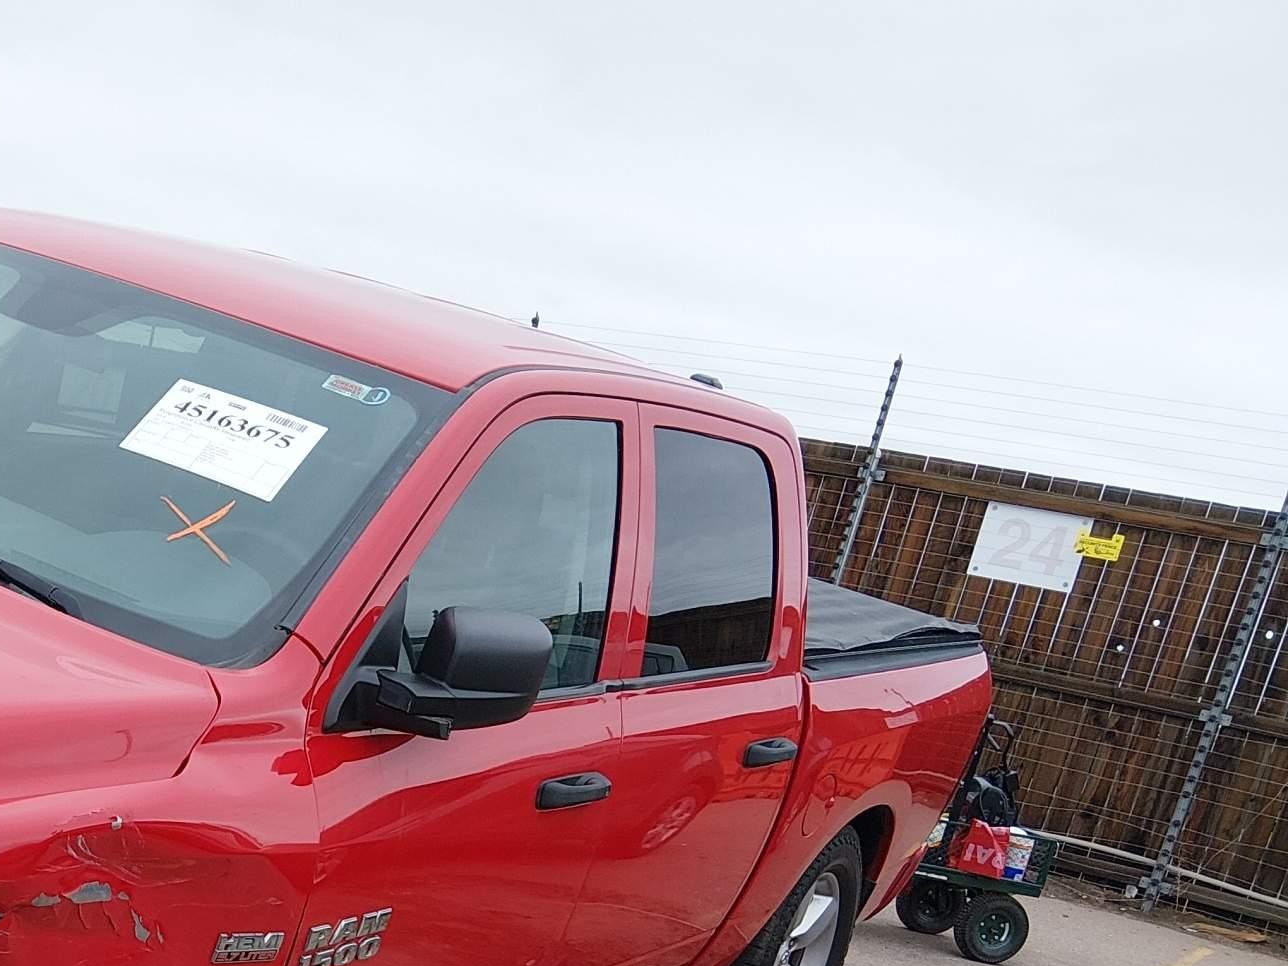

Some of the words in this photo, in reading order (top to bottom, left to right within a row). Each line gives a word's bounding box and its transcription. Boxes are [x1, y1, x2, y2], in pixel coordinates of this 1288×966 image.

[174, 400, 295, 449] 45163675
[987, 517, 1069, 576] 24
[216, 932, 285, 951] HEMI
[305, 907, 393, 951] RAM
[239, 950, 276, 961] LITER
